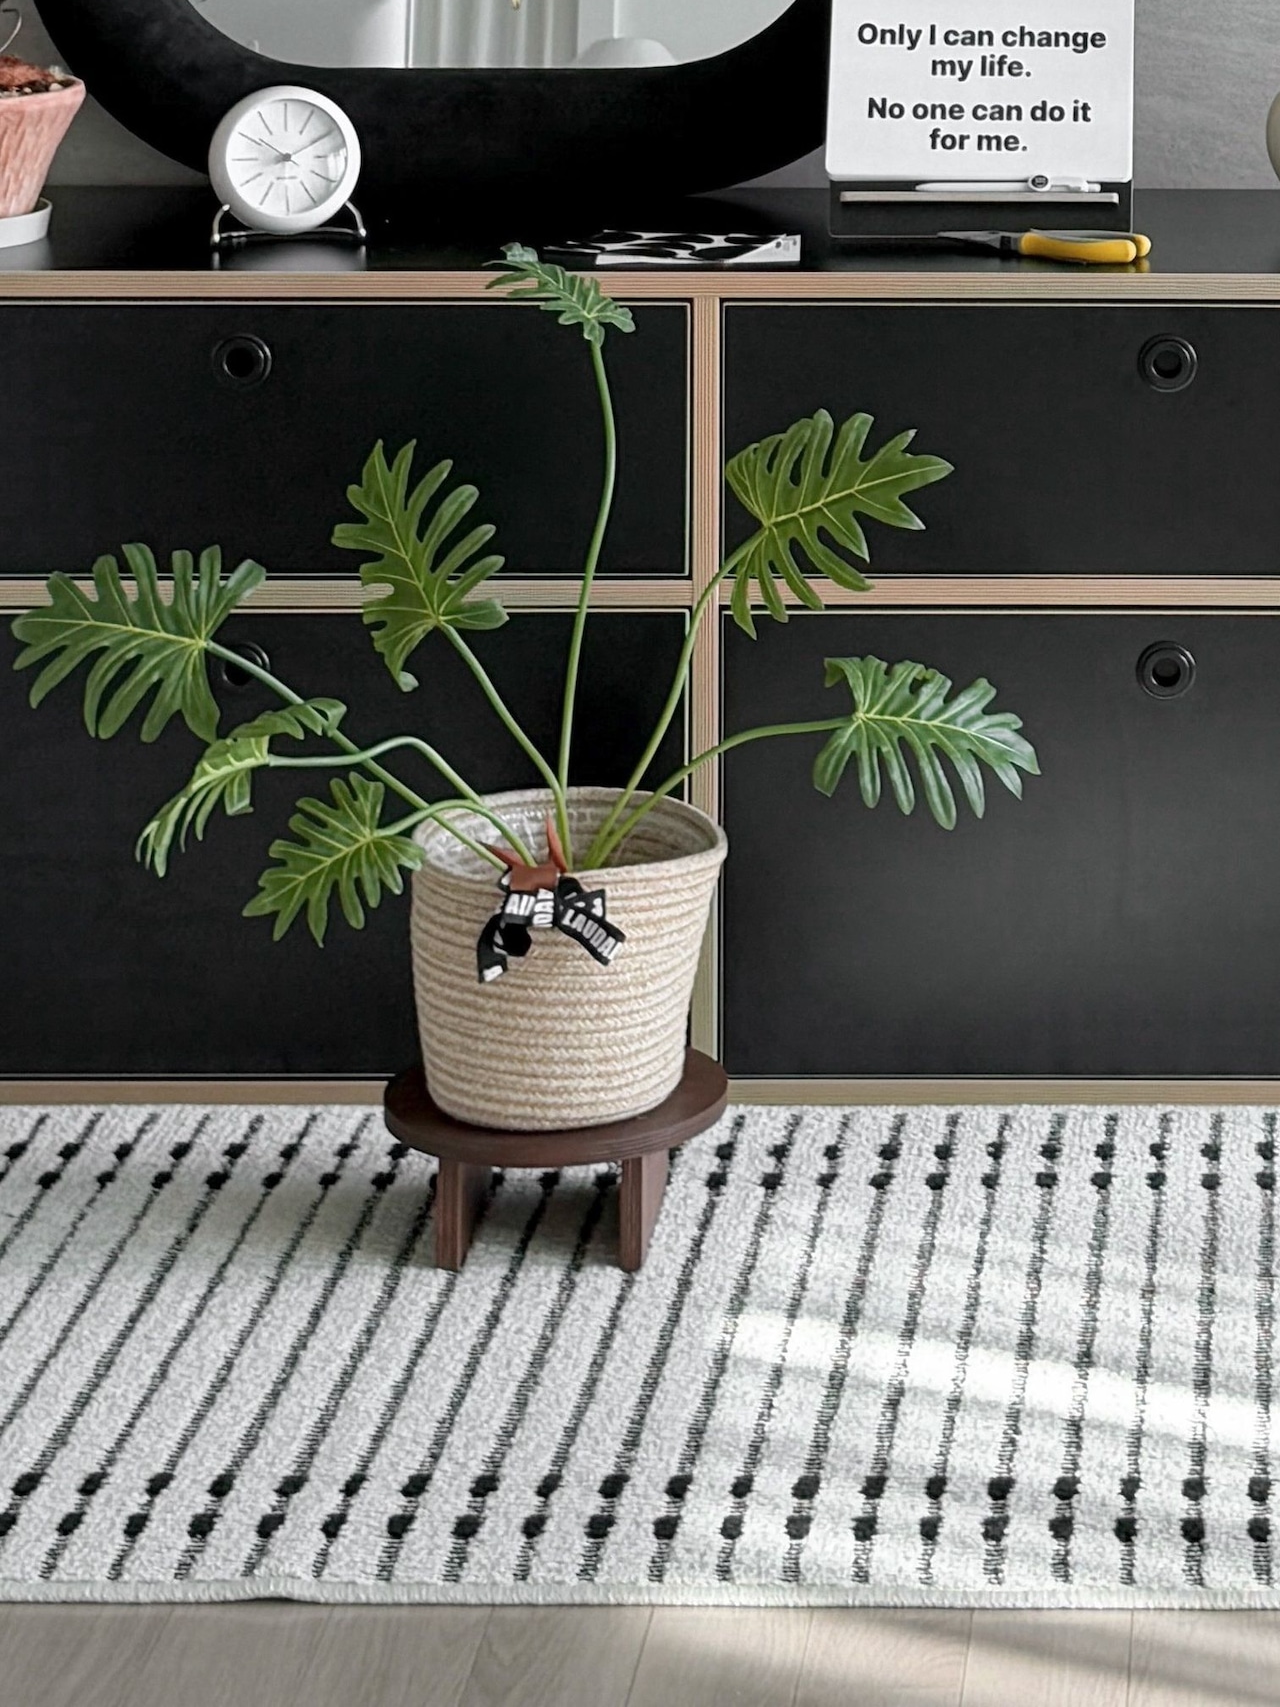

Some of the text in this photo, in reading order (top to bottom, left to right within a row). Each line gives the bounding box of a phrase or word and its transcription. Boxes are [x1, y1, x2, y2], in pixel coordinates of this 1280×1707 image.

[858, 23, 1107, 54] Only I can change
[931, 54, 1032, 82] my life.
[868, 97, 1091, 122] No one can do it
[929, 127, 1028, 152] for me.
